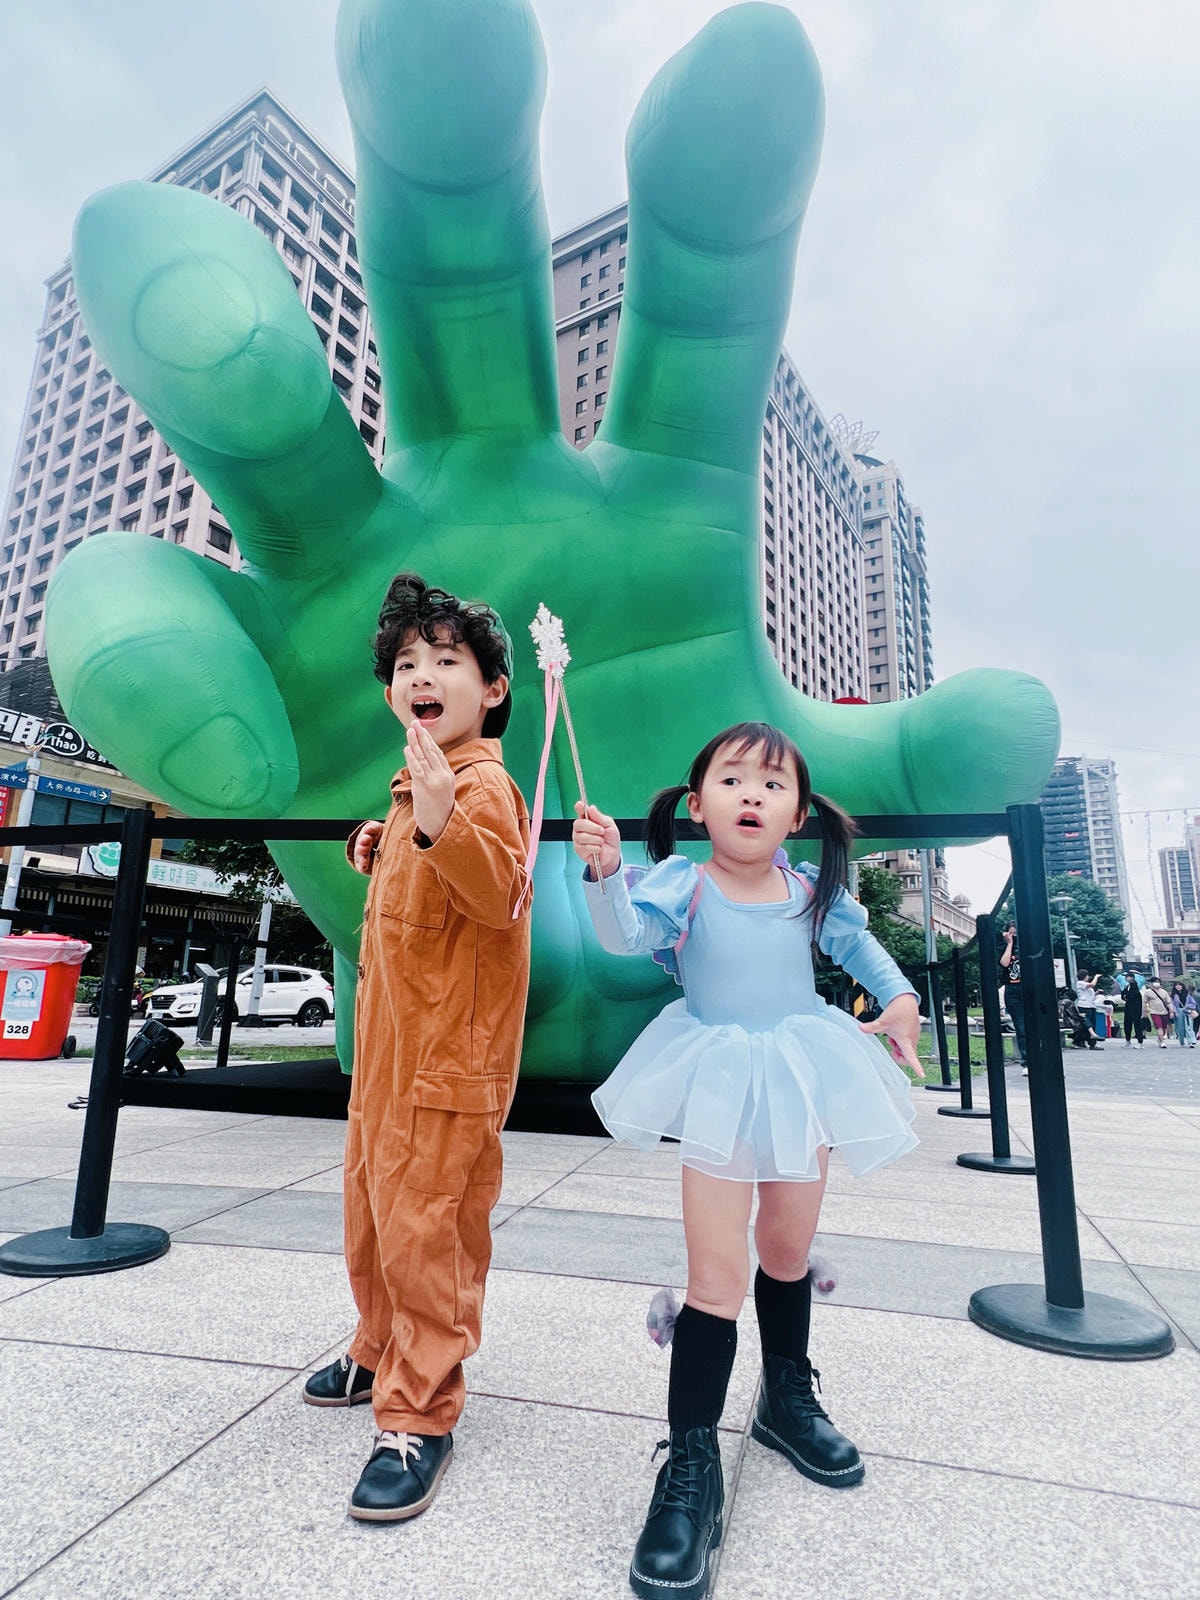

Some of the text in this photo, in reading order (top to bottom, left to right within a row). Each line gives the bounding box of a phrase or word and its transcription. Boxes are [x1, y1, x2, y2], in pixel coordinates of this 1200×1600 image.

[50, 736, 78, 751] Thao
[46, 781, 97, 798] 大興西路一段
[152, 864, 199, 886] 輕好食
[7, 1025, 29, 1034] 328
